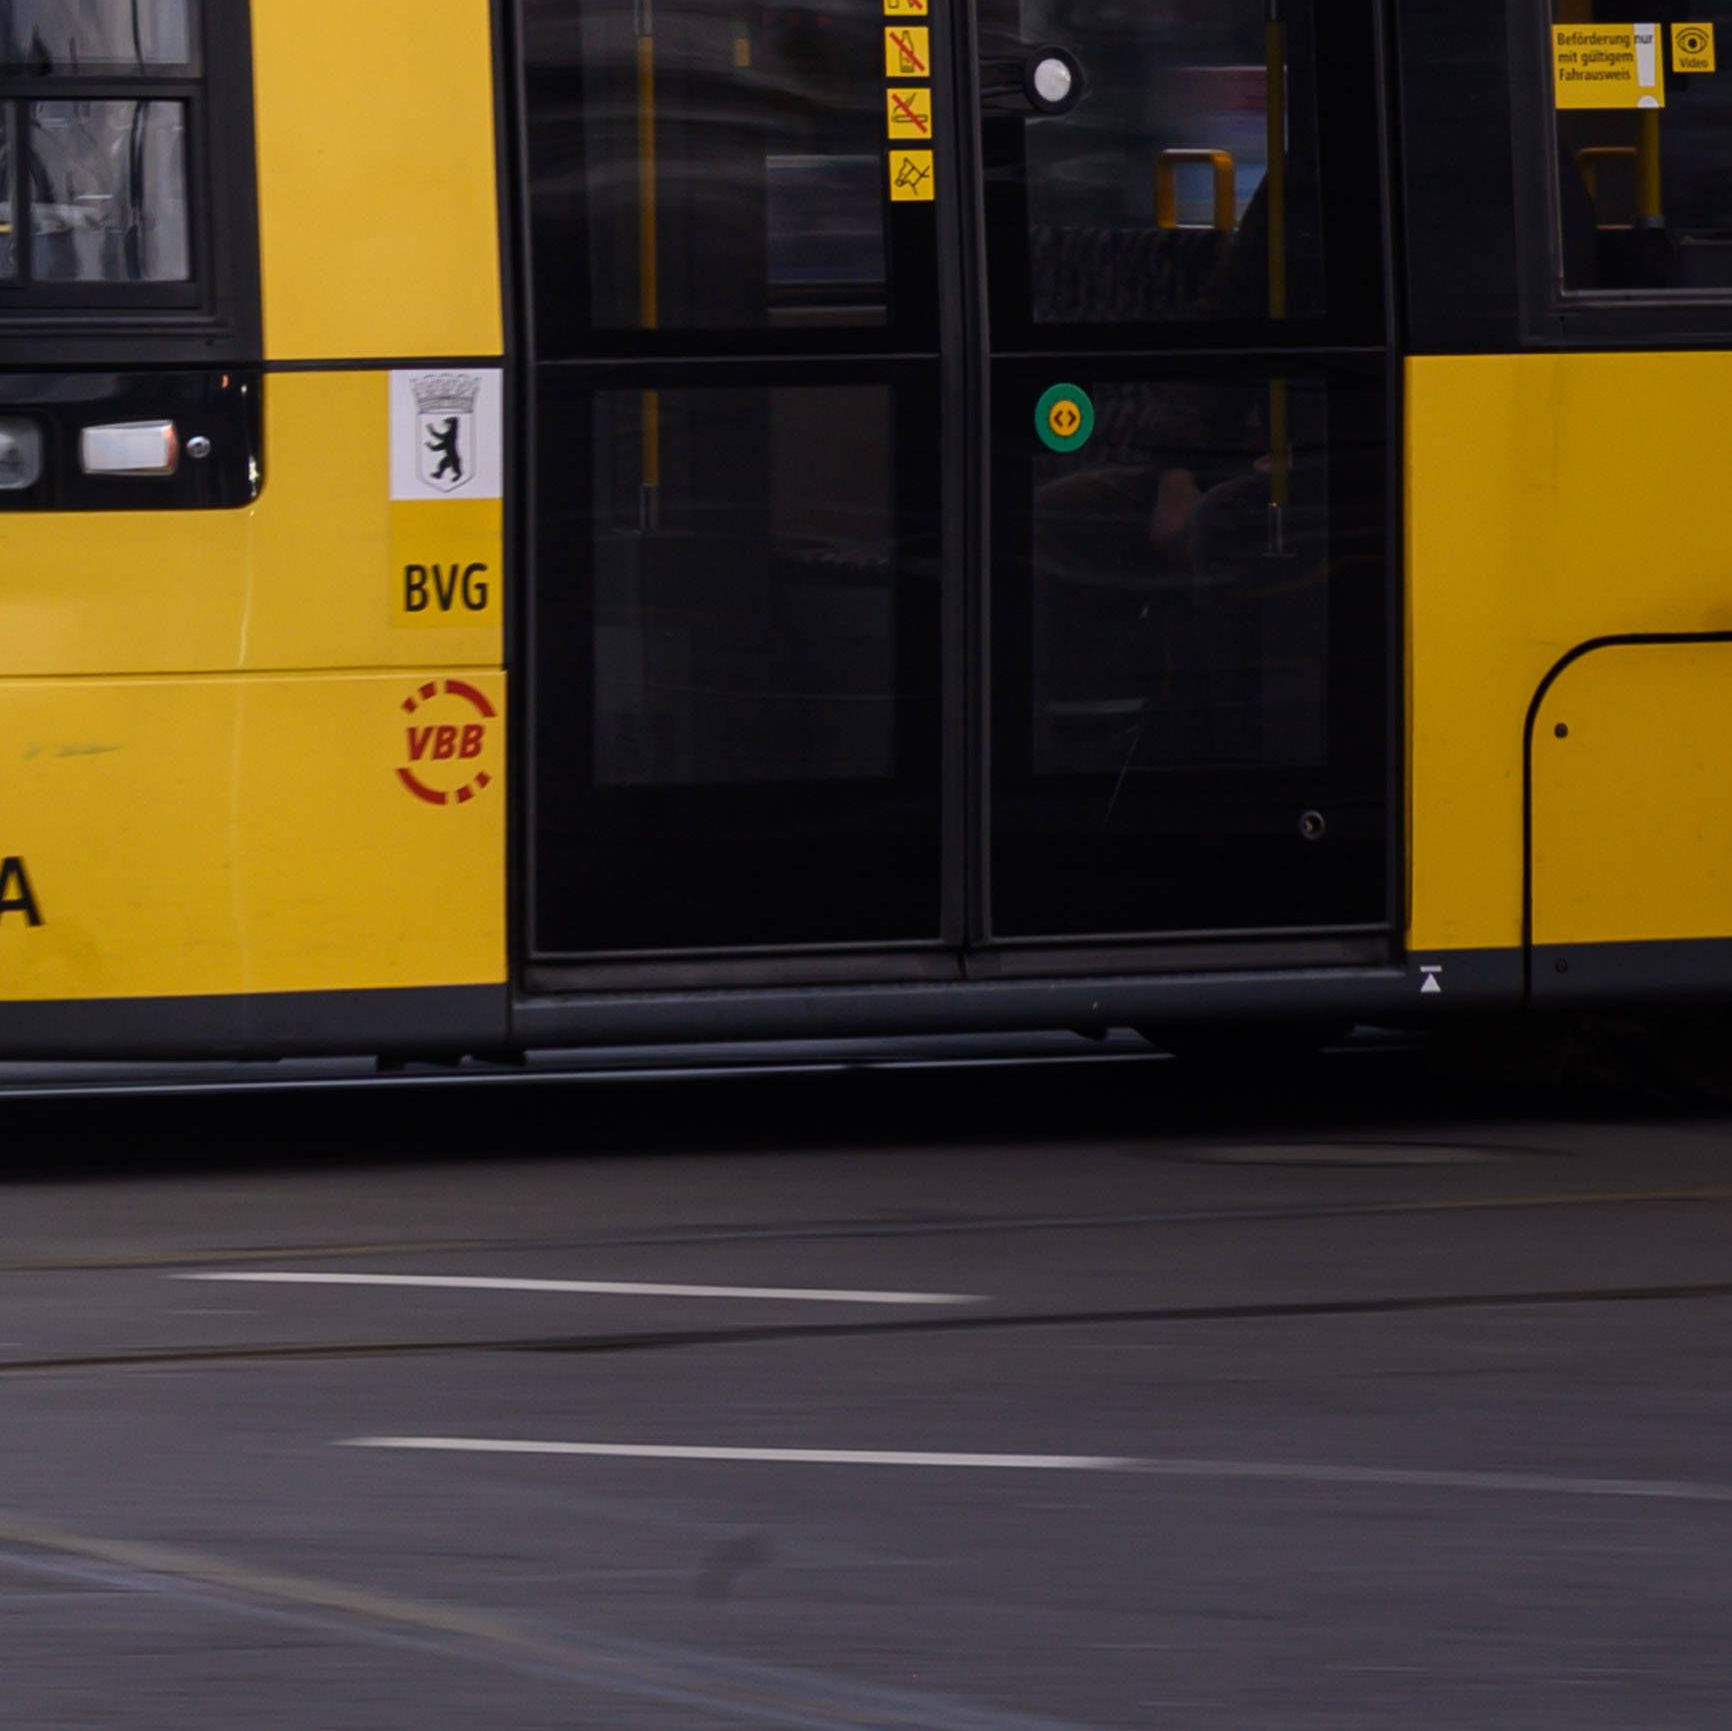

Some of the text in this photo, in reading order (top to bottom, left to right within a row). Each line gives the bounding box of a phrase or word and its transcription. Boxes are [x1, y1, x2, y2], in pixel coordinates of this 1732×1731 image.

[1557, 32, 1653, 47] Beförderung nur
[1558, 50, 1633, 66] mit gültigem
[1679, 57, 1708, 68] Video
[1559, 68, 1631, 81] Fahrausweis
[404, 563, 488, 612] BVG
[407, 724, 484, 760] VBB
